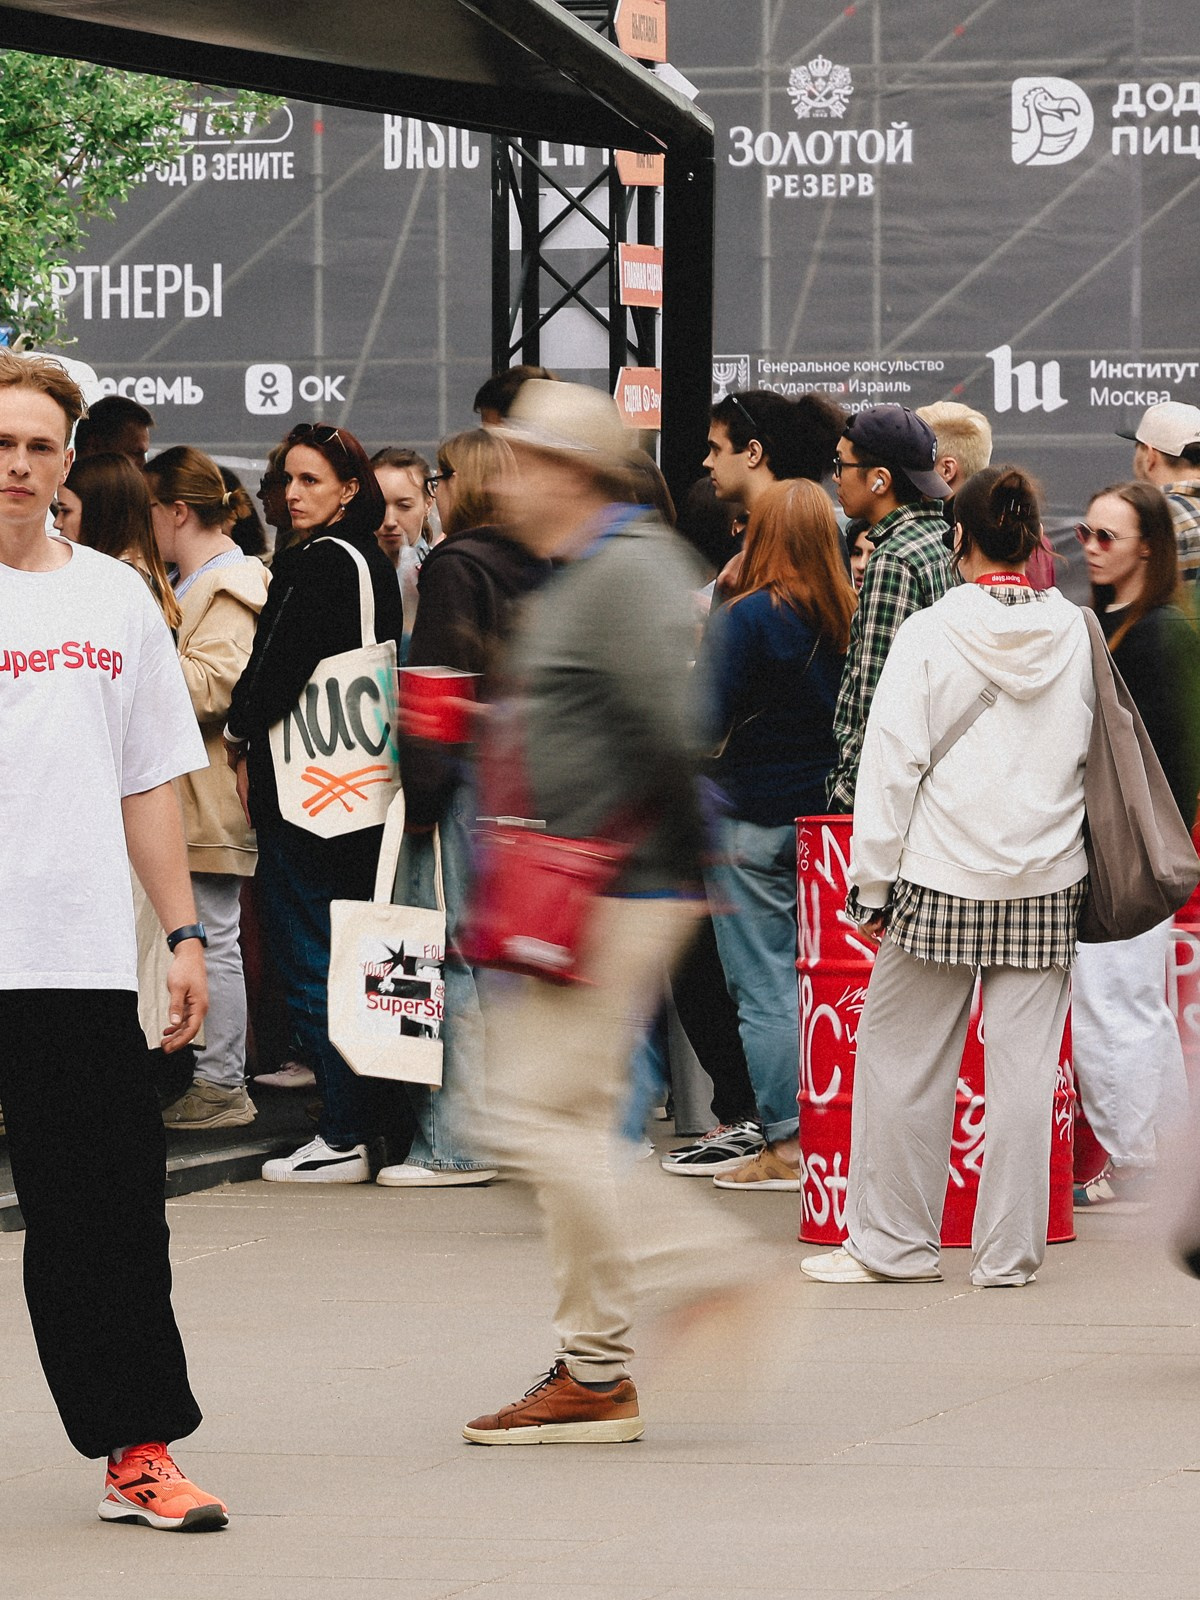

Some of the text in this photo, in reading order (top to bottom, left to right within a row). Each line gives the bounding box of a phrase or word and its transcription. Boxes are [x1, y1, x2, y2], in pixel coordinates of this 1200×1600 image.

[728, 121, 913, 167] ЗОЛОТОЙ
[192, 153, 207, 182] В
[211, 151, 295, 181] ЗЕНИТЕ
[766, 173, 875, 198] РЕЗЕРВ
[757, 358, 945, 376] Генеральное консульство
[1090, 359, 1199, 384] Институт
[849, 378, 912, 396] Израиль
[1090, 387, 1171, 406] Москва
